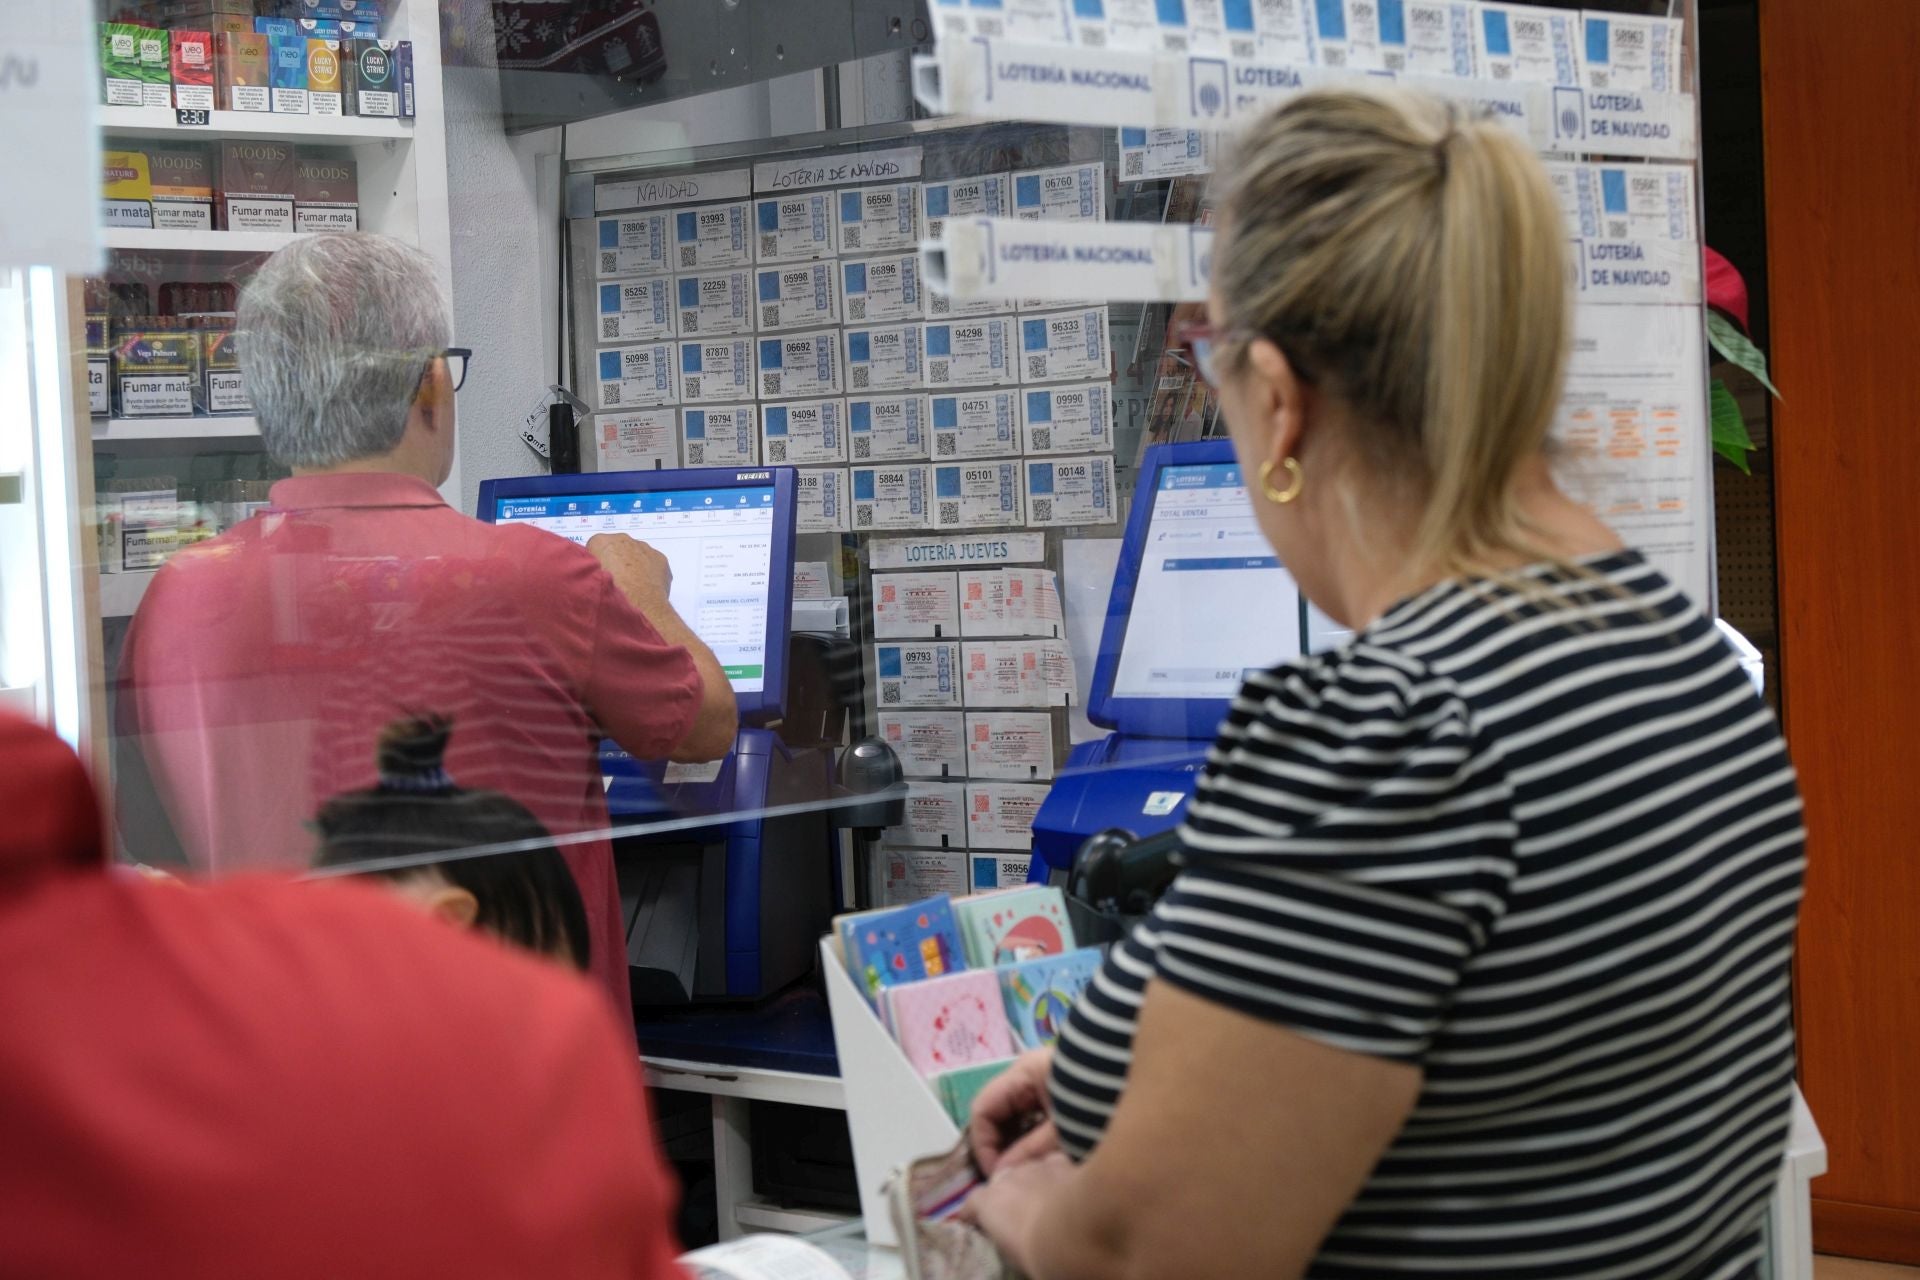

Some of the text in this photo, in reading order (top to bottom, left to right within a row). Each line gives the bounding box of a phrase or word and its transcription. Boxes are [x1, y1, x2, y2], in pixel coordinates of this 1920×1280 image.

[114, 38, 132, 46] veo
[142, 44, 160, 52] veo
[184, 46, 202, 54] veo
[240, 48, 258, 56] neo
[280, 50, 298, 58] neo
[314, 57, 332, 66] LUCKY
[366, 56, 383, 64] LUCKY
[314, 66, 333, 74] STRIKE
[366, 65, 385, 74] STRIKE
[999, 62, 1152, 92] LOTERÍA NACIONAL
[1235, 65, 1302, 88] LOTERÍA
[1589, 93, 1644, 113] LOTERÍA
[1590, 120, 1671, 140] DE NAVIDAD
[232, 146, 286, 160] MOODS
[152, 156, 202, 170] MOODS
[103, 168, 134, 177] NATURE
[298, 167, 349, 180] MOODS
[830, 166, 848, 181] DE
[1045, 176, 1072, 188] 06760
[636, 181, 700, 205] NAVIDAD
[953, 186, 979, 198] 00194
[866, 194, 892, 205] 66550
[122, 208, 150, 218] mata
[153, 208, 206, 218] Fumar mata
[232, 206, 289, 217] Fumar mata
[782, 203, 806, 214] 05841
[298, 212, 353, 223] Fumar mata
[700, 213, 725, 224] 93993
[622, 222, 645, 232] 78806
[1001, 240, 1153, 265] LOTERÍA NACIONAL
[1590, 244, 1644, 262] LOTERÍA
[870, 264, 896, 275] 66896
[784, 272, 808, 283] 05998
[1591, 269, 1671, 286] DE NAVIDAD
[703, 280, 726, 291] 22259
[624, 286, 648, 297] 85252
[1052, 321, 1079, 332] 96333
[955, 328, 983, 339] 94298
[874, 335, 899, 344] 94094
[705, 348, 729, 357] 87870
[786, 342, 811, 353] 06692
[626, 353, 649, 364] 50998
[88, 370, 103, 384] ta
[123, 382, 191, 393] Fumar mata
[1056, 393, 1083, 405] 09990
[875, 405, 900, 415] 00434
[962, 400, 989, 411] 04751
[708, 415, 731, 424] 99794
[791, 410, 816, 420] 94094
[522, 431, 547, 453] somfy
[965, 470, 993, 481] 05101
[1058, 466, 1085, 477] 00148
[879, 474, 904, 484] 58844
[906, 541, 1008, 562] LOTERÍA JUEVES
[906, 651, 931, 662] 09793
[1002, 863, 1029, 874] 38956
